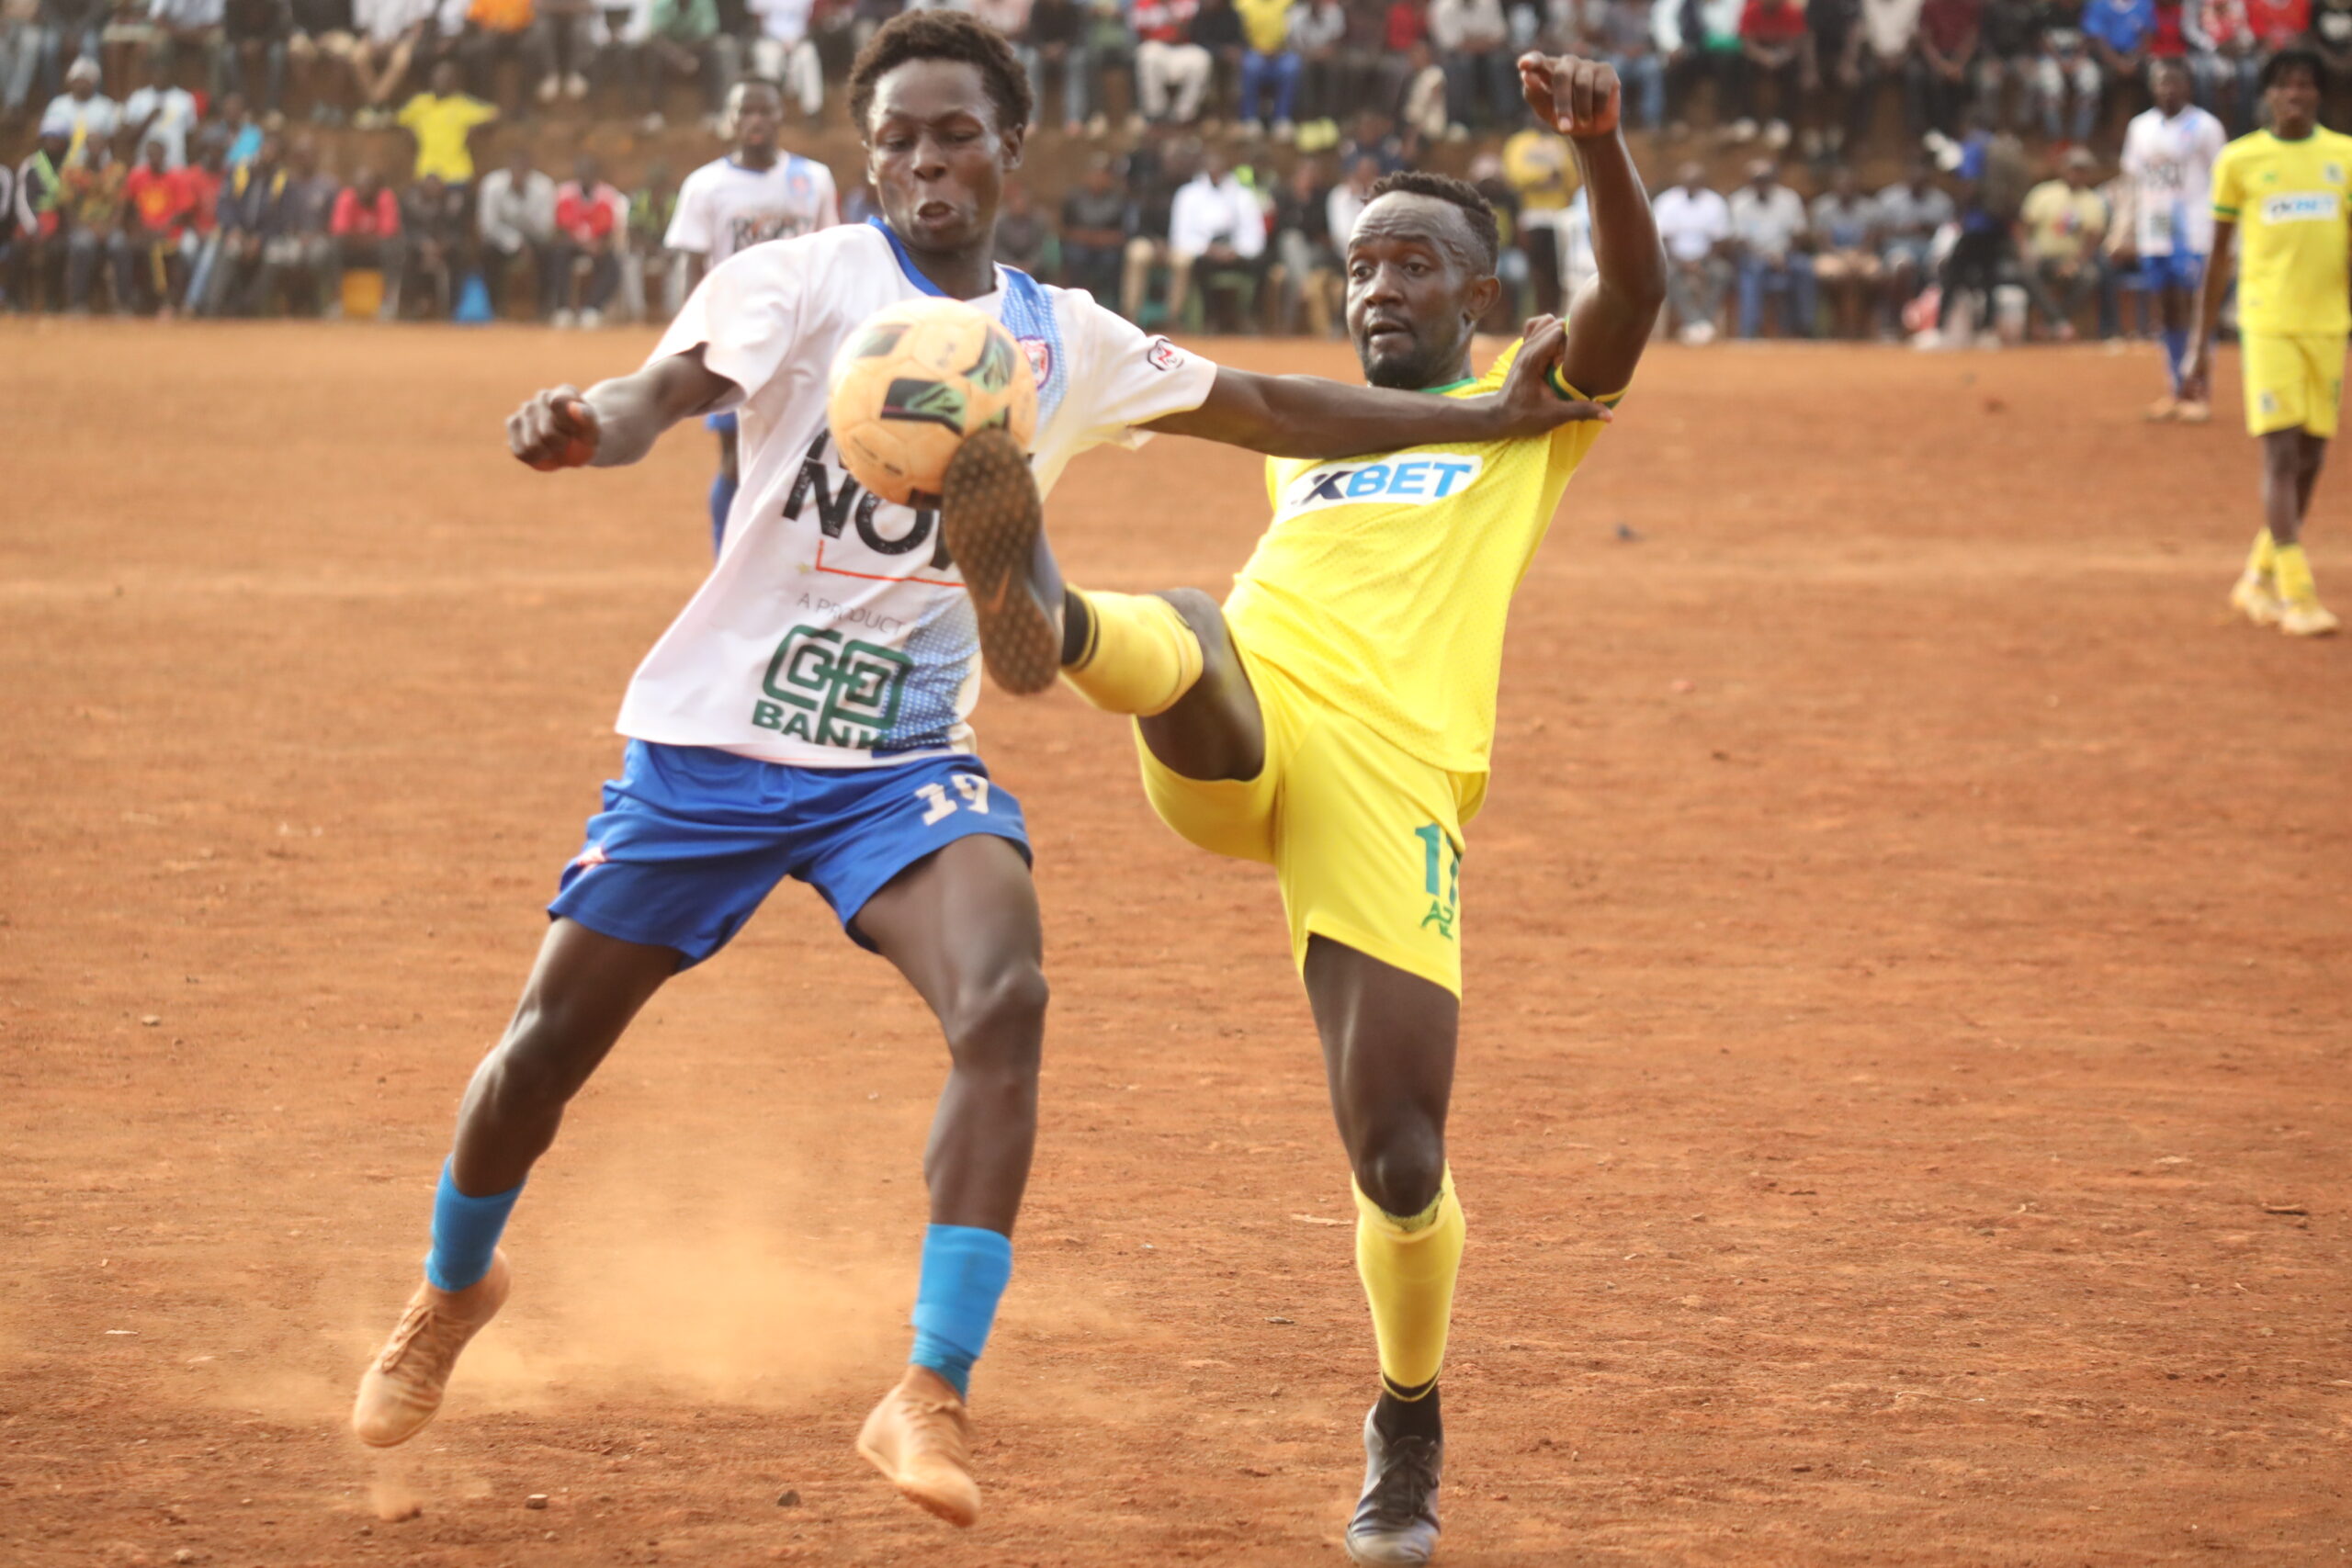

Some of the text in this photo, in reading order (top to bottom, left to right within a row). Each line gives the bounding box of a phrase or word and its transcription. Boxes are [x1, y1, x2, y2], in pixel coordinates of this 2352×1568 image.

[1291, 461, 1472, 505] XBET
[797, 592, 810, 610] A
[915, 773, 989, 826] 19
